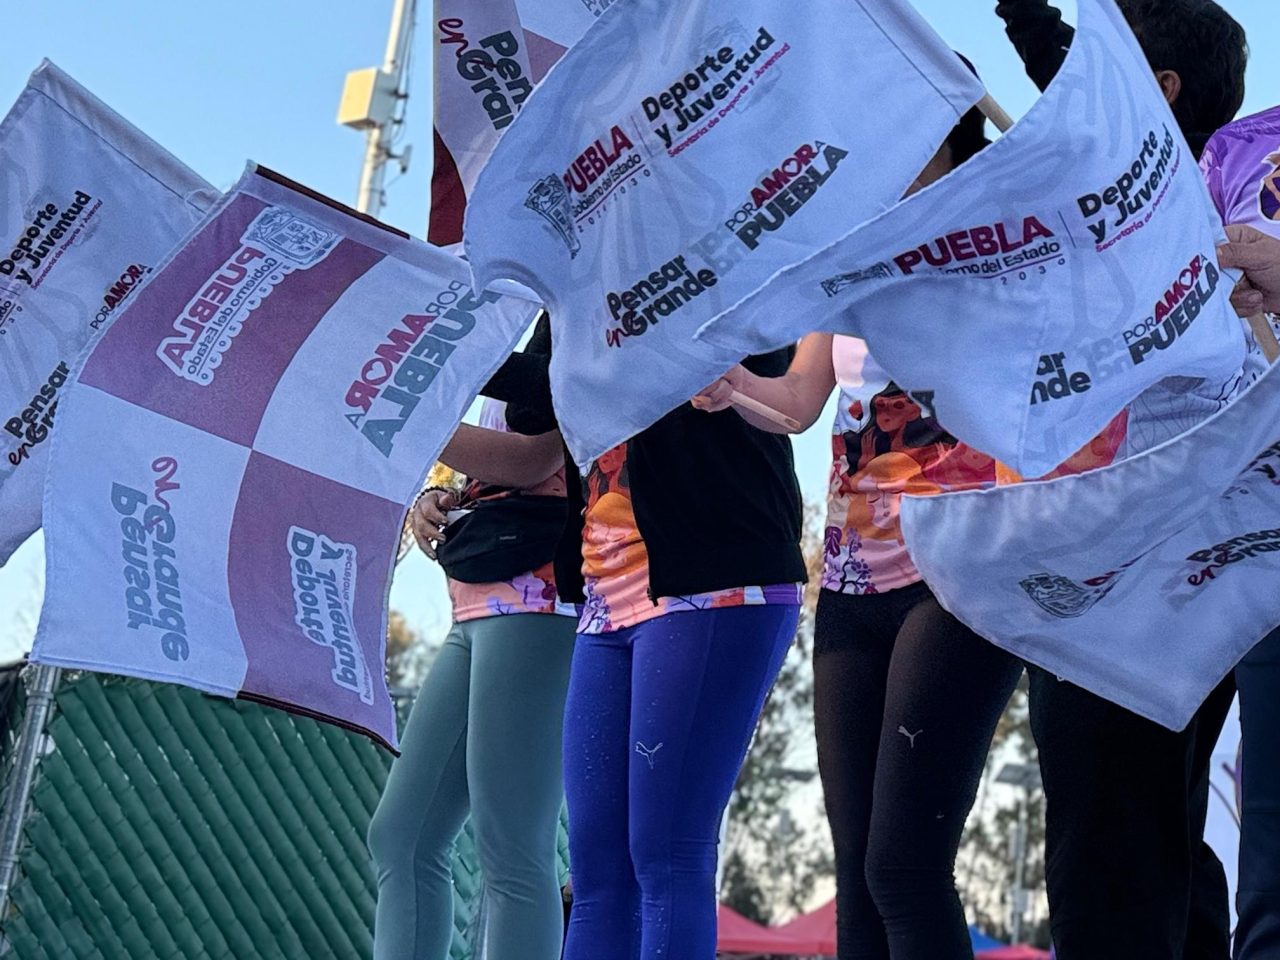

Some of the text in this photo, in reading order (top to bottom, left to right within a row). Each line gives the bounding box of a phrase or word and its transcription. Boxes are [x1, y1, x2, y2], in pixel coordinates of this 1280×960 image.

[456, 49, 515, 131] Gra
[478, 30, 534, 112] Pen
[641, 46, 735, 122] Deporte
[654, 26, 775, 149] y Juventud
[725, 201, 757, 232] POR
[751, 143, 818, 209] AMOR
[735, 145, 849, 251] PUEBLA
[1077, 130, 1158, 218] Deporte
[1087, 218, 1106, 245] y
[1115, 121, 1174, 227] Juventud
[0, 202, 58, 275] Deporte
[15, 190, 92, 285] y Juventud
[893, 215, 1055, 275] PUEBLA
[981, 258, 1003, 274] del
[1003, 241, 1061, 267] Estado
[90, 305, 113, 330] POR
[104, 264, 141, 311] AMOR
[606, 254, 688, 321] Pensar
[1122, 315, 1157, 344] POR
[1154, 254, 1202, 325] AMOR
[1127, 261, 1220, 366] PUEBLA
[3, 360, 70, 440] Pensar
[1030, 368, 1092, 406] nde
[1254, 463, 1277, 480] y
